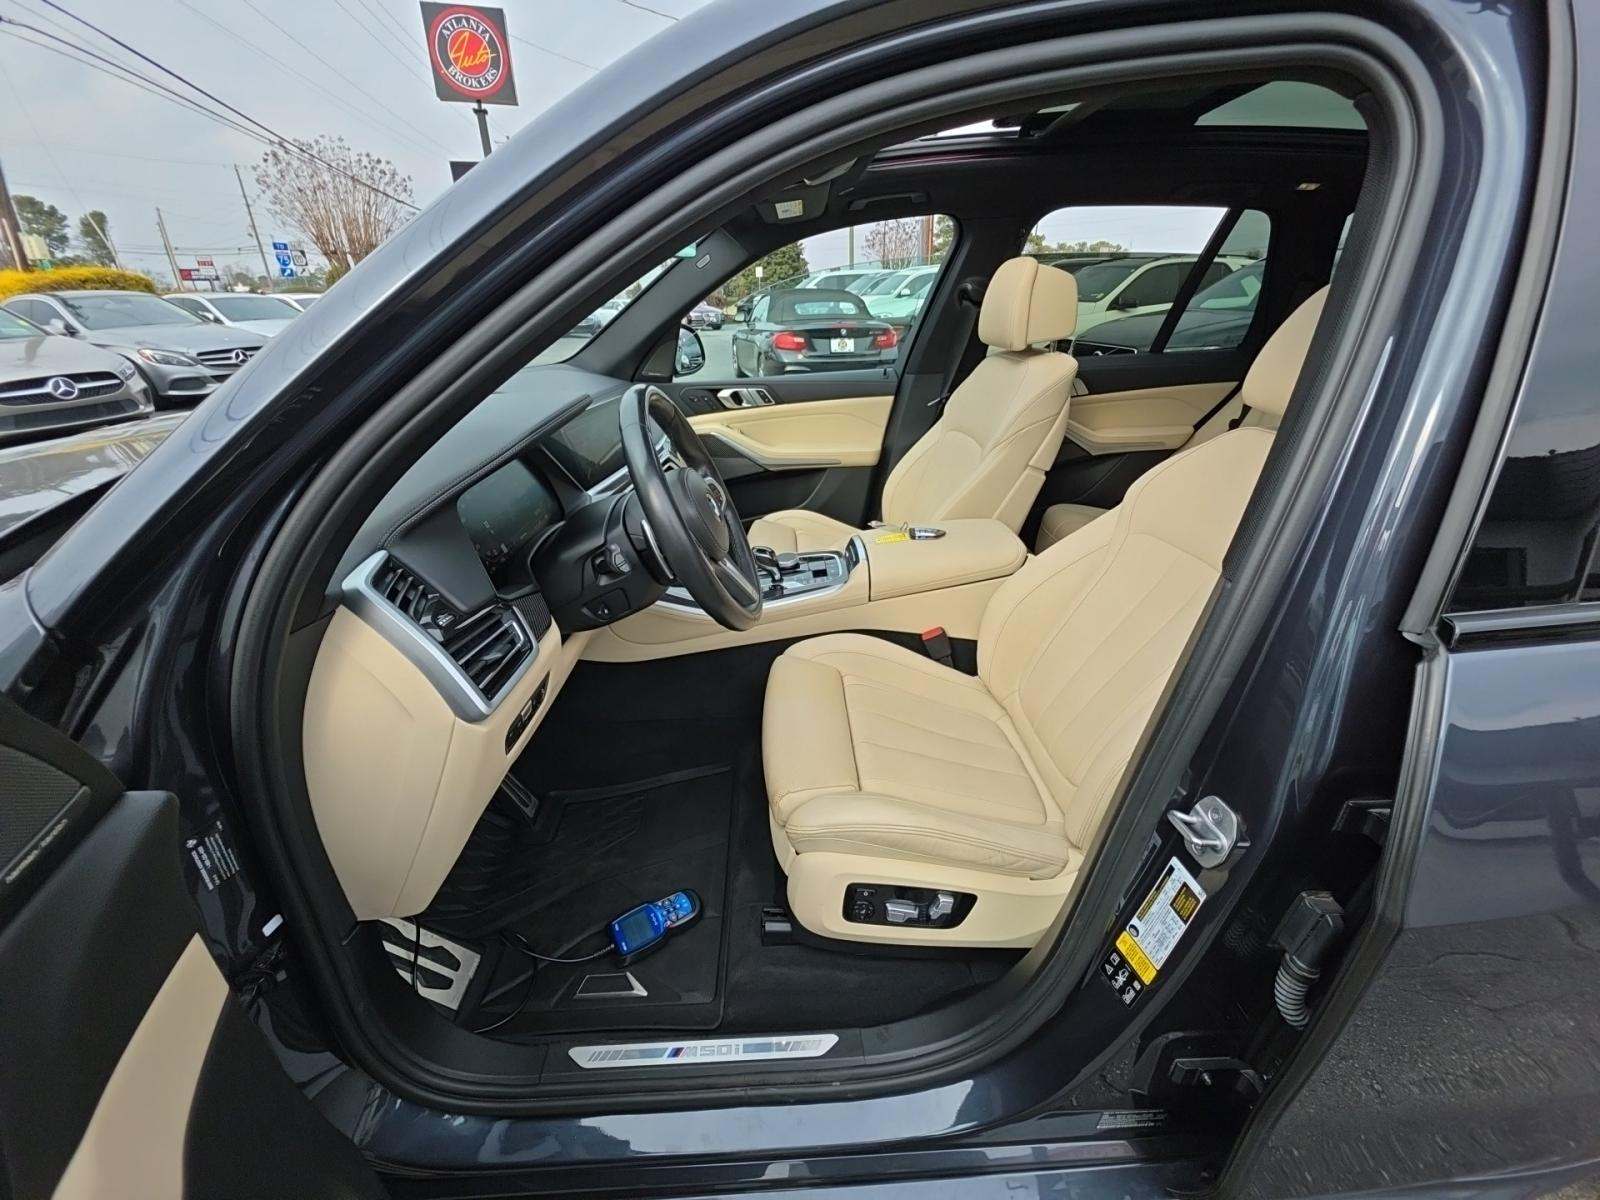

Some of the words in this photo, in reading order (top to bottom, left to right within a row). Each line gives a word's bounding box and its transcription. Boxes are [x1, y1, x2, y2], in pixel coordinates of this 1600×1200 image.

[441, 17, 490, 41] ATLANTA
[450, 30, 497, 70] Auto
[447, 65, 498, 88] BROKERS
[278, 254, 290, 265] 75
